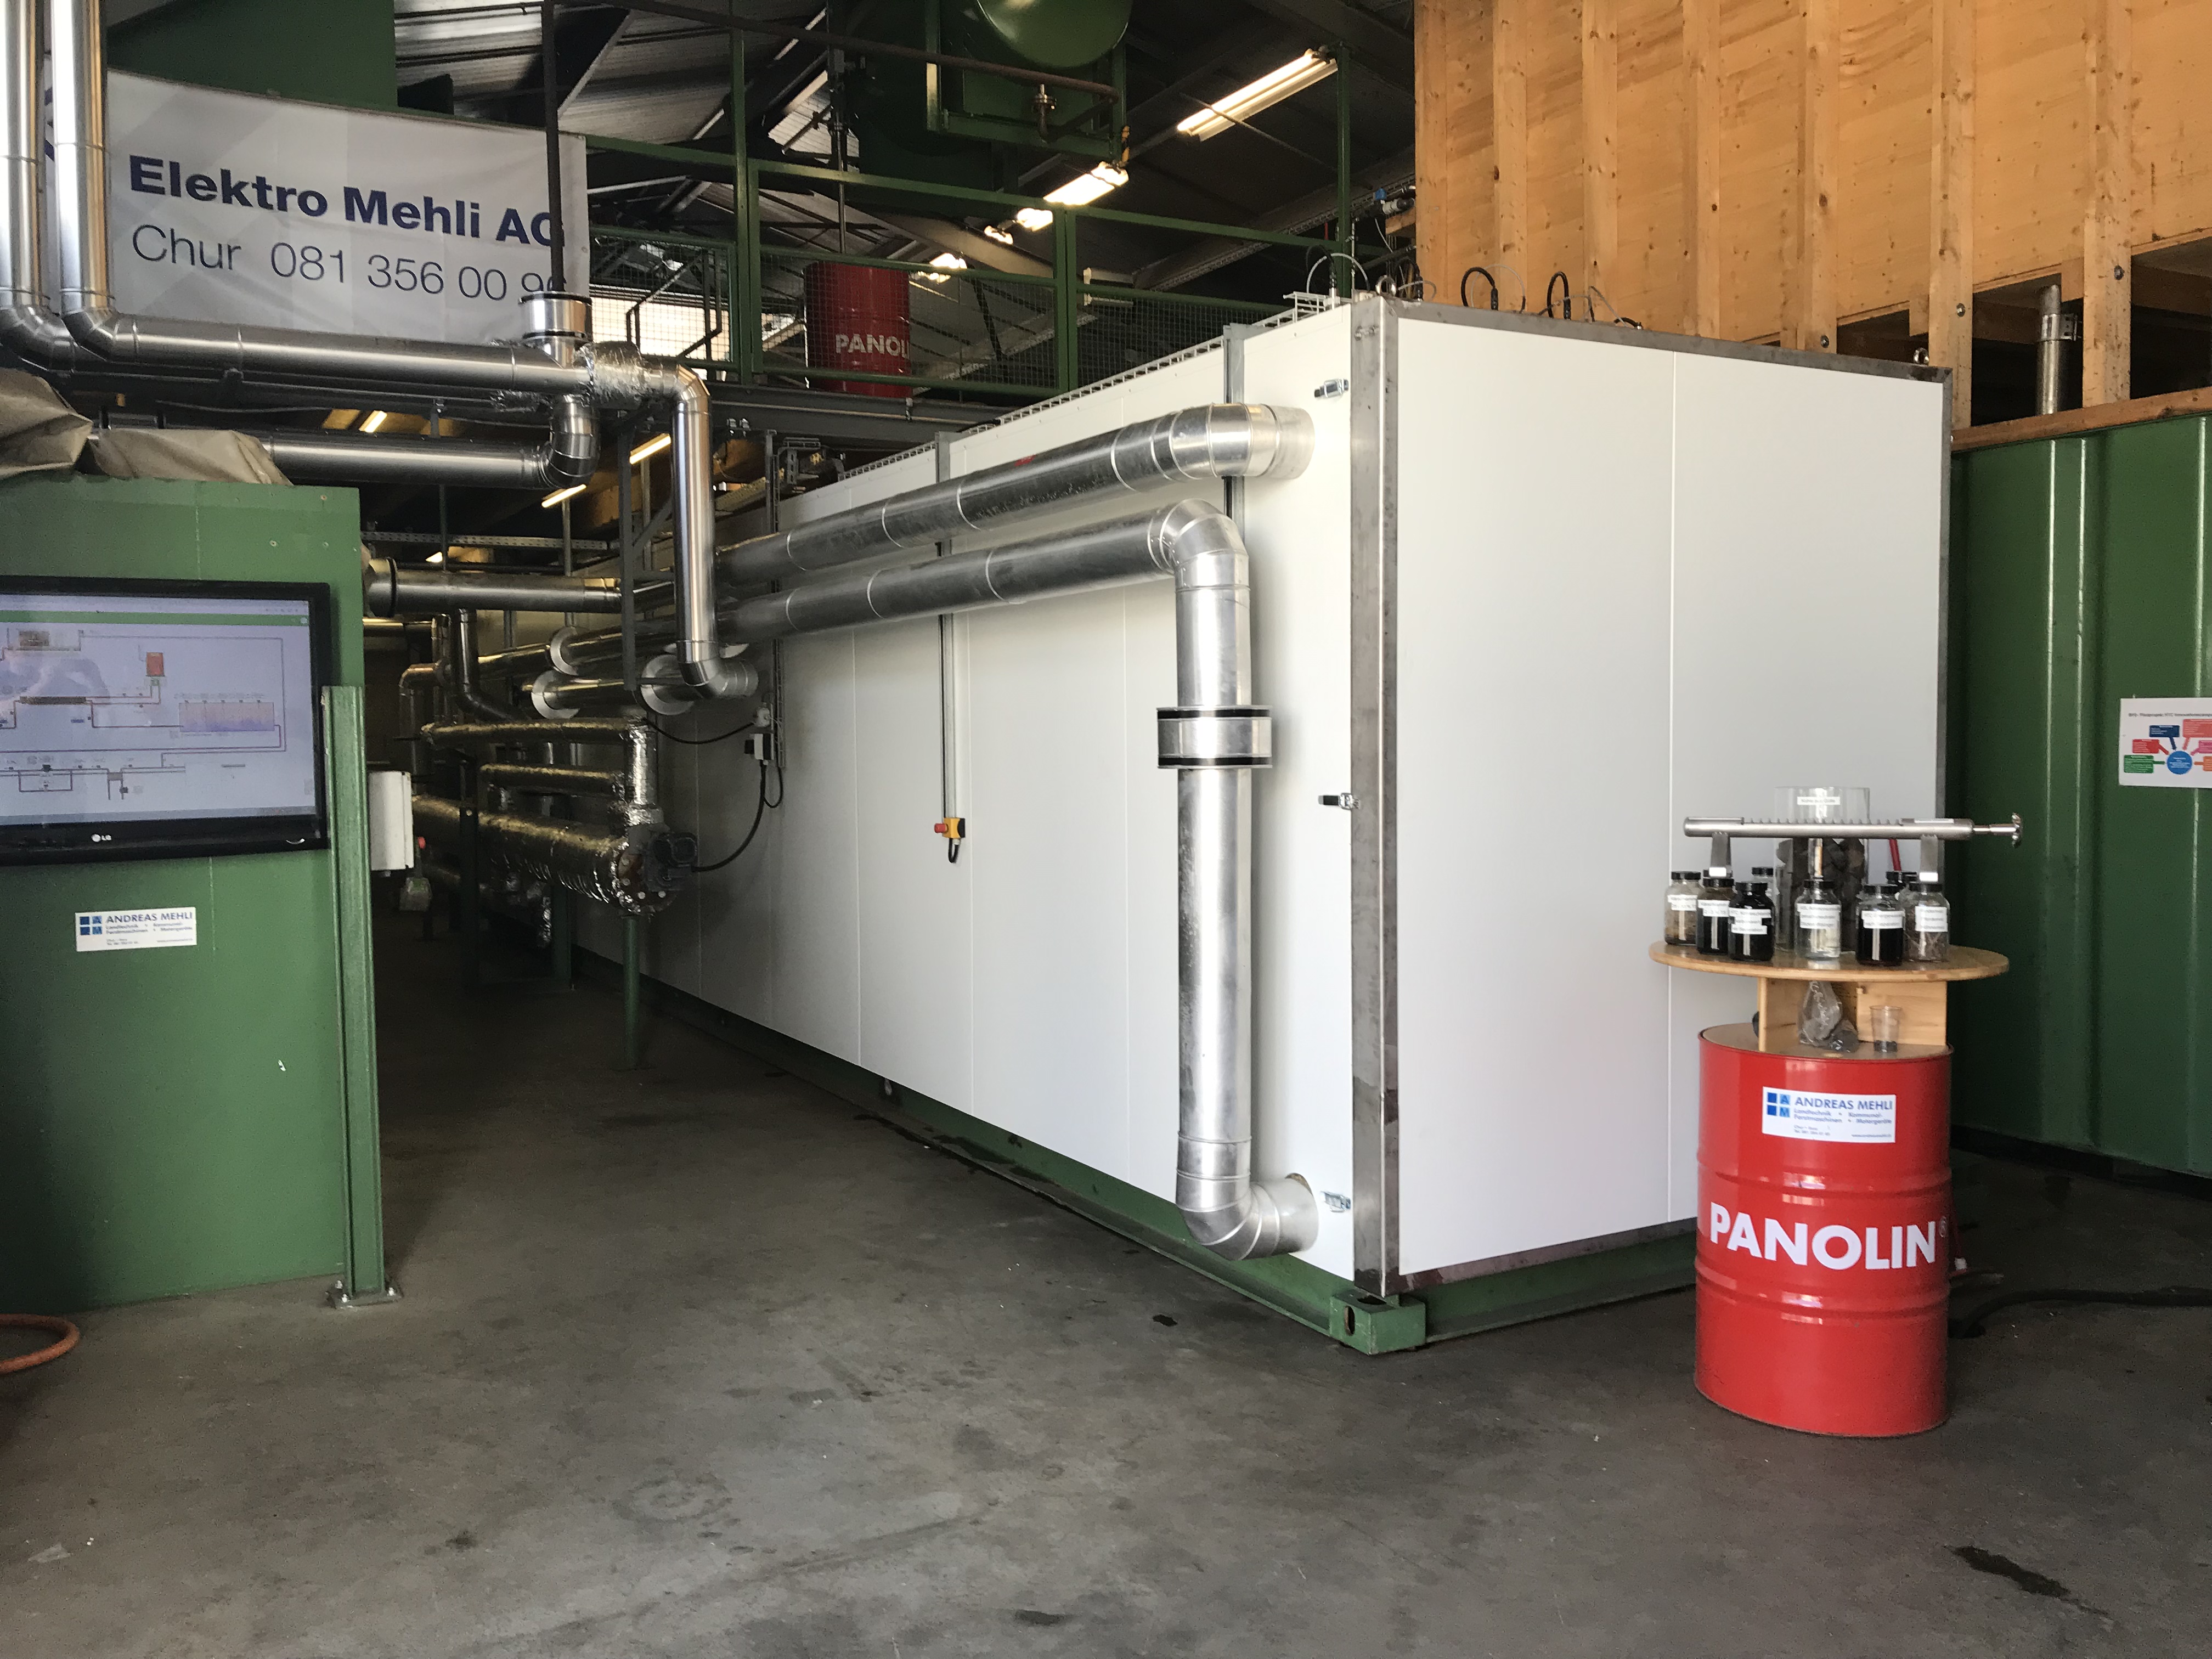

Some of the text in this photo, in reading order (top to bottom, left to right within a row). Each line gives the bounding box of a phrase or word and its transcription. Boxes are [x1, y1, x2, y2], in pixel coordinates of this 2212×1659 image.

[129, 154, 328, 217] Elektro
[343, 186, 480, 238] Mehli
[133, 224, 241, 270] Chur
[270, 242, 344, 283] 081
[368, 255, 444, 294] 356
[459, 266, 507, 301] 00
[106, 911, 193, 923] ANDREAS MEHLI
[1795, 1097, 1893, 1110] ANDREAS MEHLI
